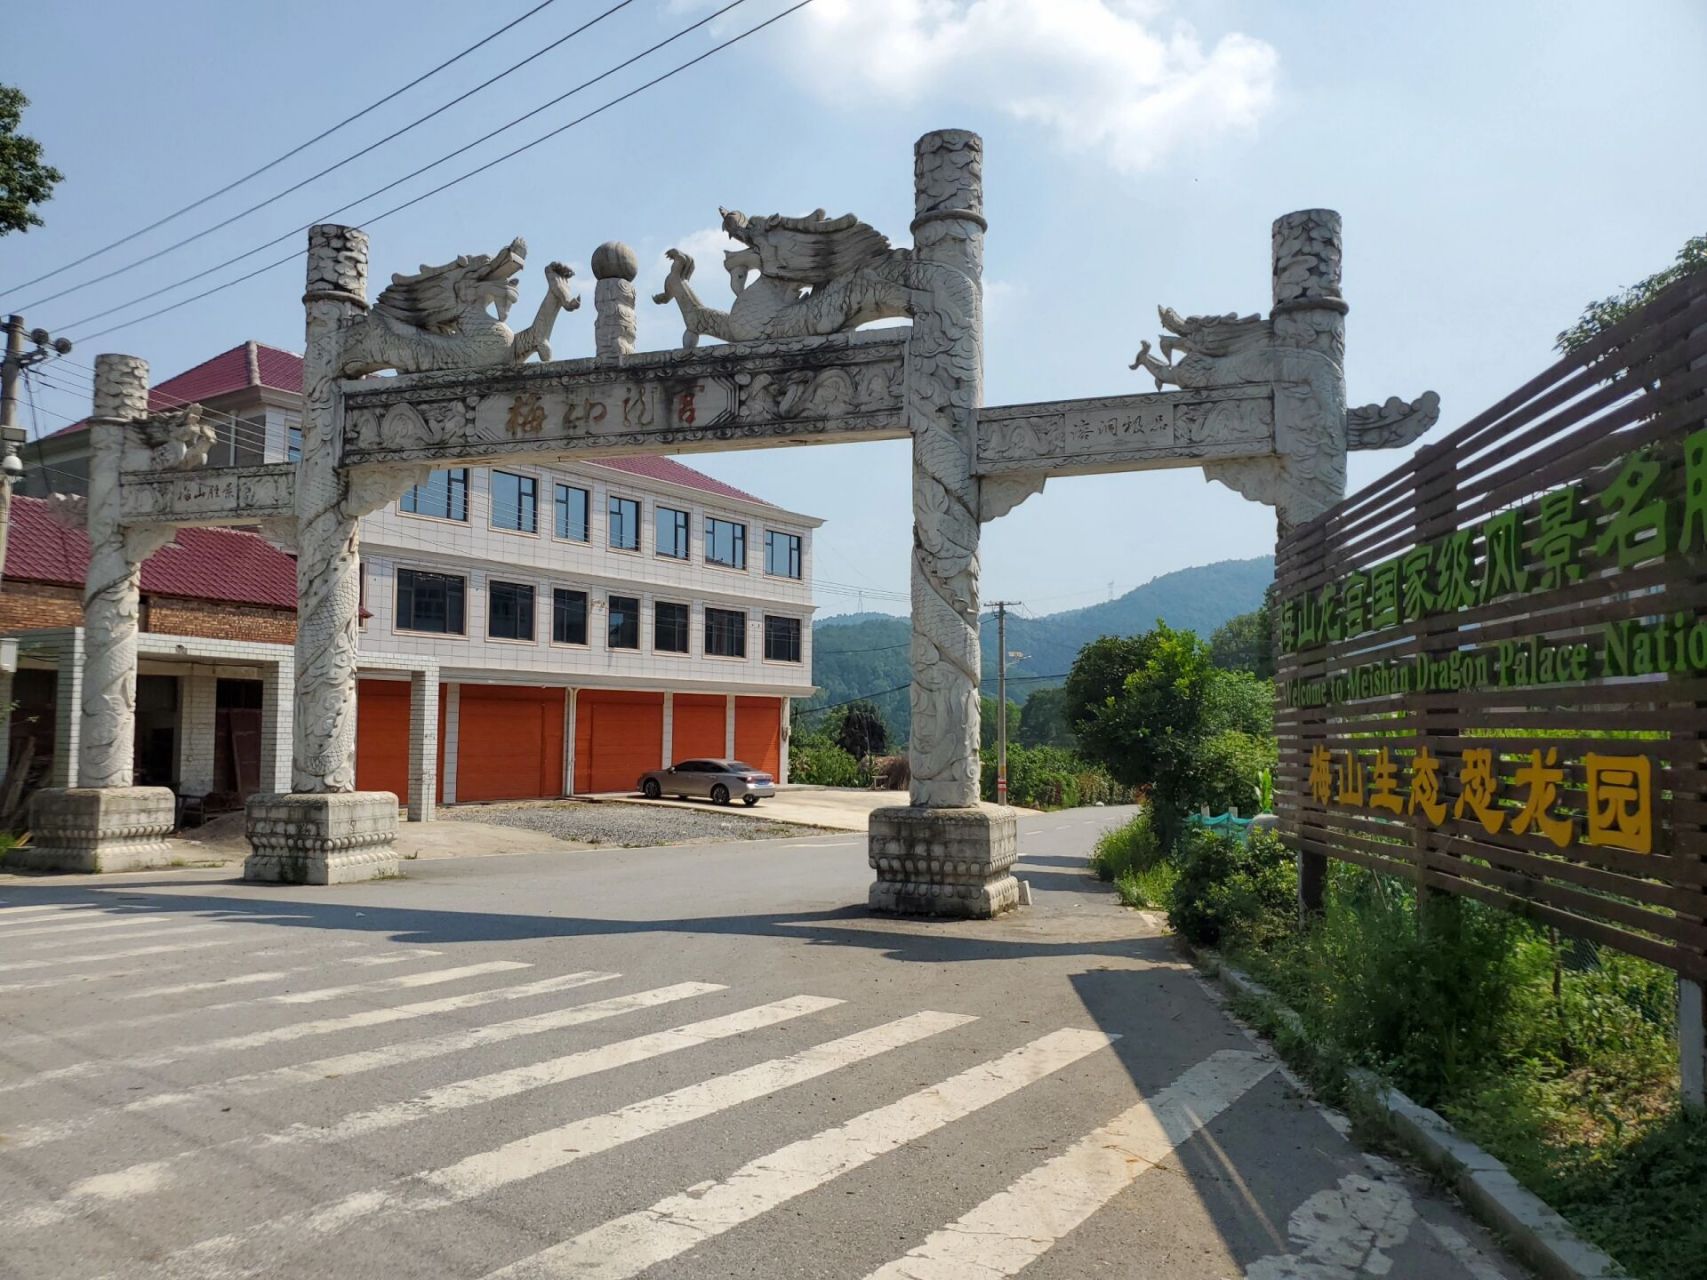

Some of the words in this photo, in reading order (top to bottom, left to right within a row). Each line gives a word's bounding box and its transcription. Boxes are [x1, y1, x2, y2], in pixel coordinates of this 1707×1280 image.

[1284, 678, 1327, 707] Welcome
[1331, 680, 1344, 704] to
[1347, 663, 1410, 699] Meishan
[1415, 650, 1488, 692] Dragon
[1499, 636, 1588, 687] Palace
[1308, 744, 1652, 855] 梅山生态恐龙园
